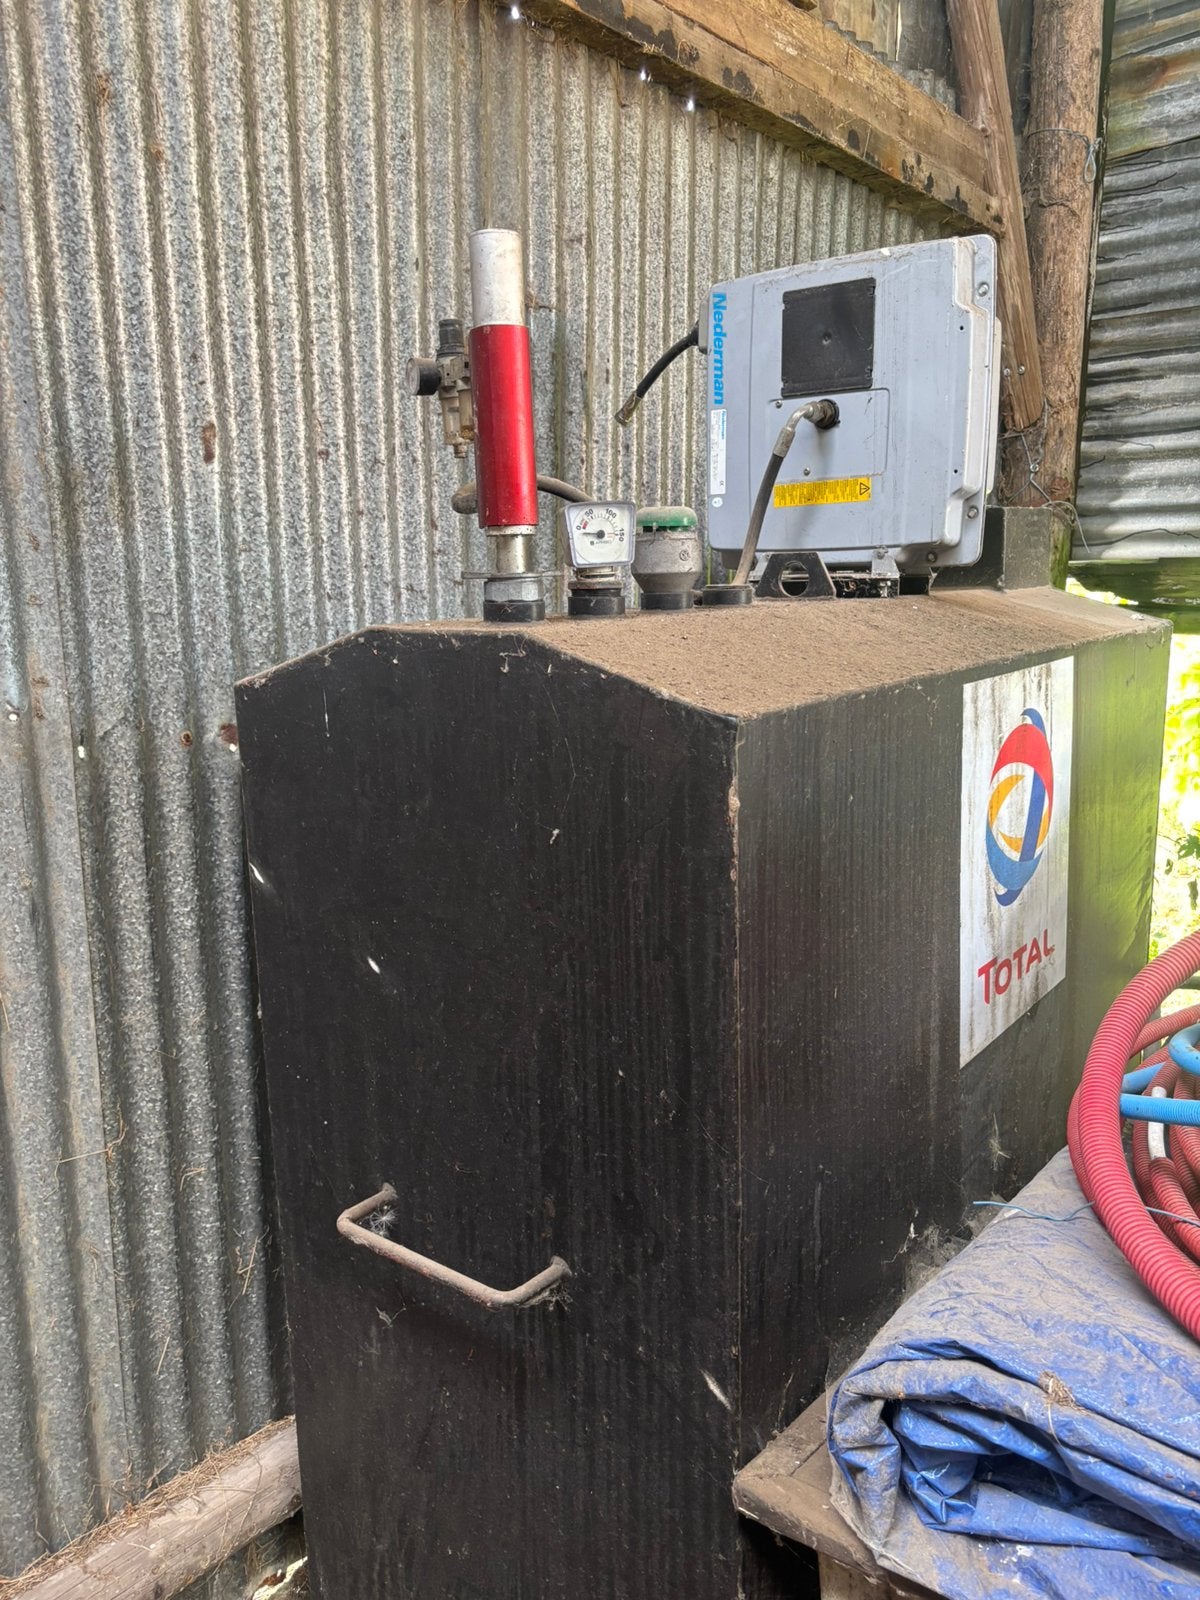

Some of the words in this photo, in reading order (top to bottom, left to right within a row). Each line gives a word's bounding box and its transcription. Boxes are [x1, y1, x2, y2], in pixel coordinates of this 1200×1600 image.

[712, 293, 727, 405] Nederman
[585, 508, 593, 517] 50
[606, 508, 616, 518] 100
[977, 928, 1055, 1005] TOTAL
